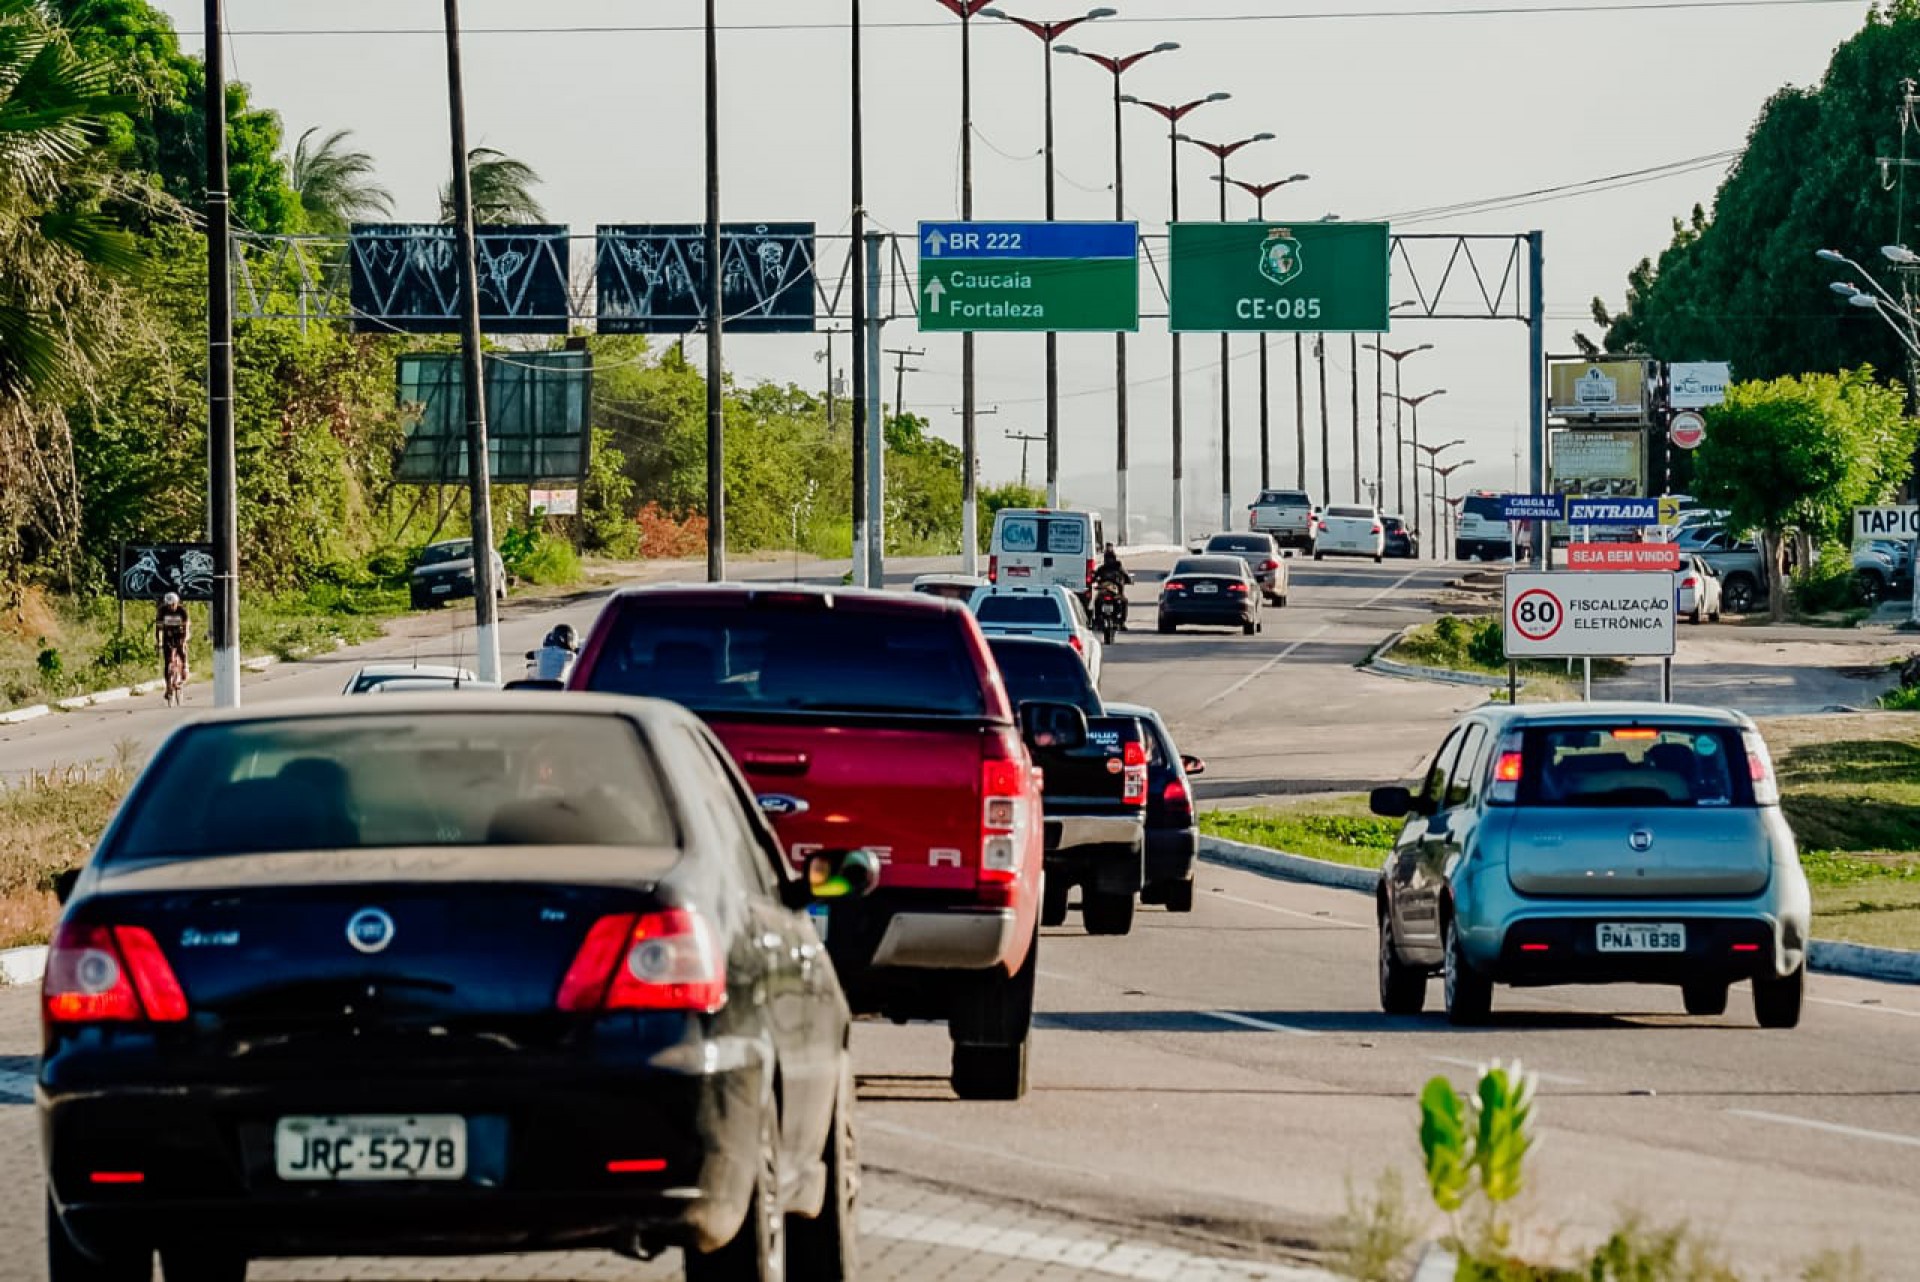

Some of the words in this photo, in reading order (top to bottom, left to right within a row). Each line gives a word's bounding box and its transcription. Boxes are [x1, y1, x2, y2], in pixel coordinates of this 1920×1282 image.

[949, 233, 980, 250] BR
[986, 233, 1022, 250] 222
[949, 271, 1032, 289] Caucaia
[949, 300, 1044, 318] Fortaleza
[1236, 297, 1321, 319] CE-085
[1511, 498, 1546, 507] CARGA
[1547, 498, 1555, 507] E
[1505, 507, 1561, 517] DESCARGA
[1571, 504, 1656, 519] ENTRADA
[1572, 551, 1605, 562] SEJA
[1607, 551, 1633, 562] BEM
[1635, 551, 1674, 563] VINDO
[1521, 601, 1555, 622] 80
[1569, 596, 1669, 612] FISCALIZAÇÃO
[1574, 615, 1663, 629] ELETRÔNICA
